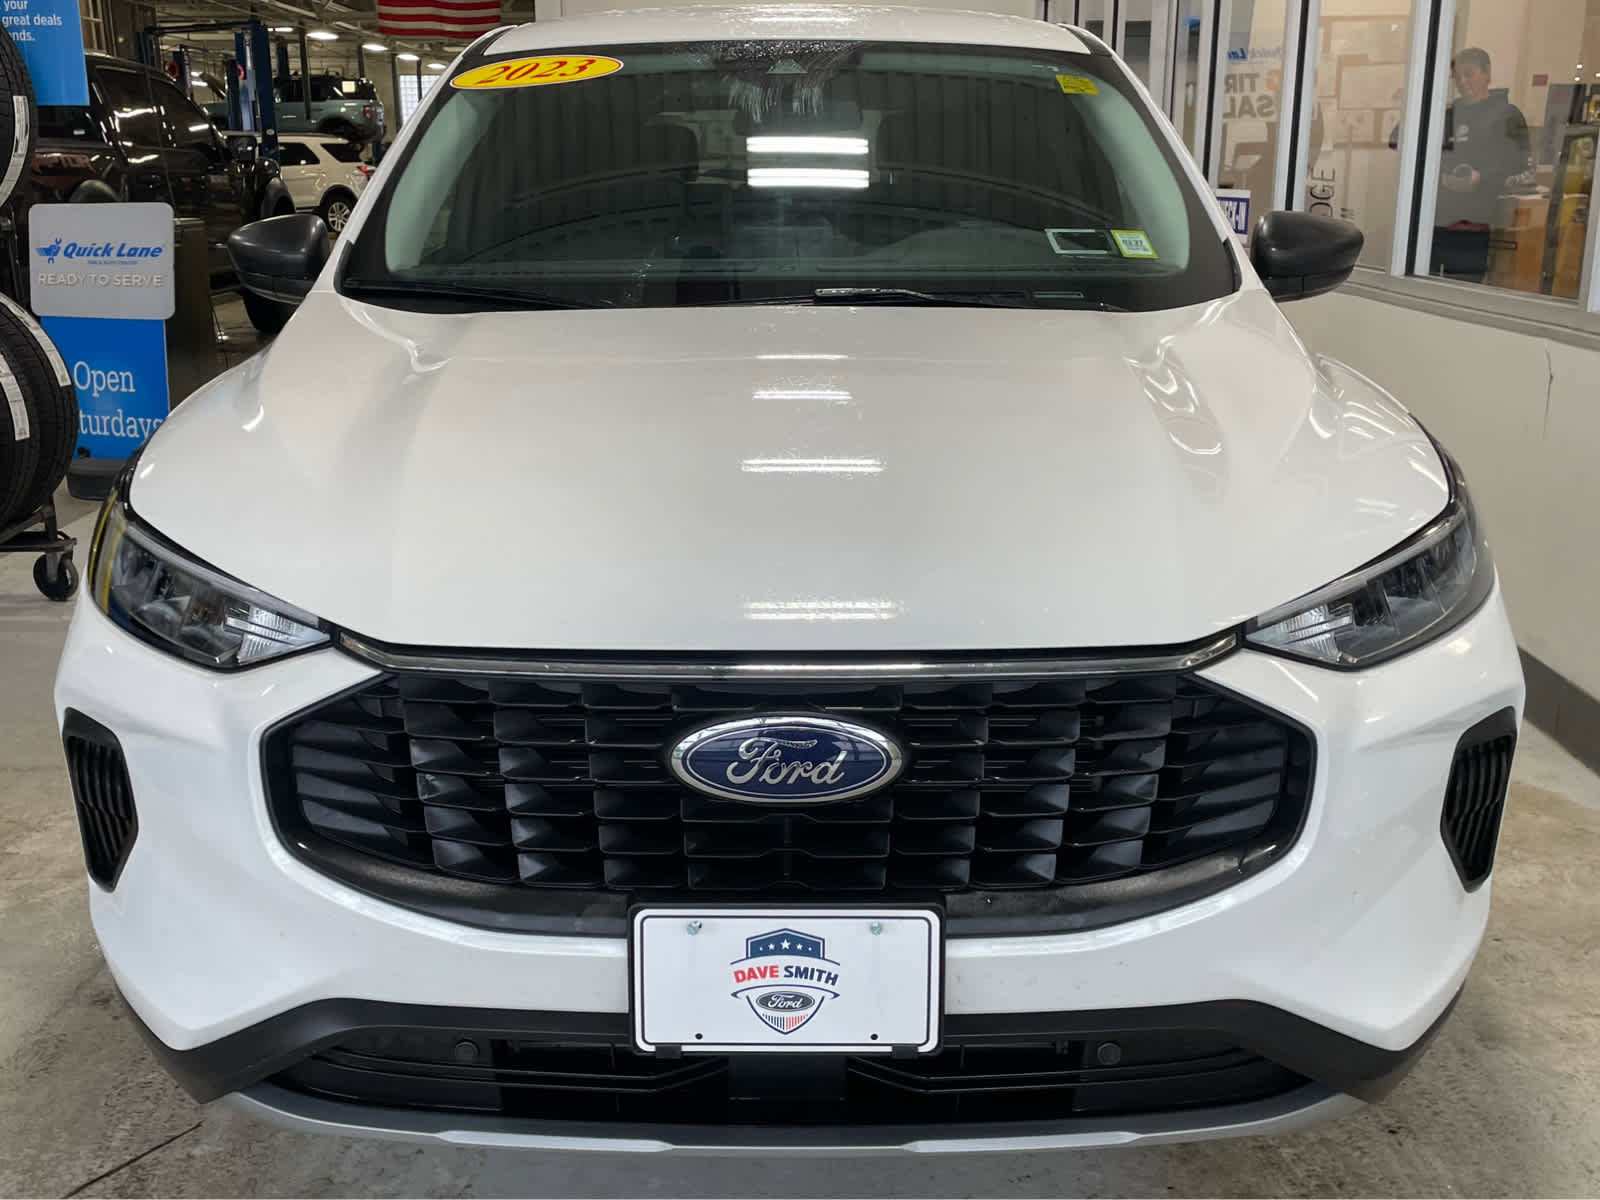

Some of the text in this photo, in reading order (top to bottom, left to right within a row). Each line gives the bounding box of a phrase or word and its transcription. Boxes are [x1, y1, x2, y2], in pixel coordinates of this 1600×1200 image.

[4, 0, 28, 12] your
[2, 13, 63, 28] great deals
[9, 29, 36, 41] nds.
[475, 59, 596, 84] 2023
[63, 242, 163, 259] Quick Lane
[38, 273, 163, 287] READY TO SERVE
[73, 361, 136, 397] Open
[726, 737, 848, 785] Ford
[733, 965, 839, 986] DAVE SMITH
[767, 993, 803, 1009] Ford
